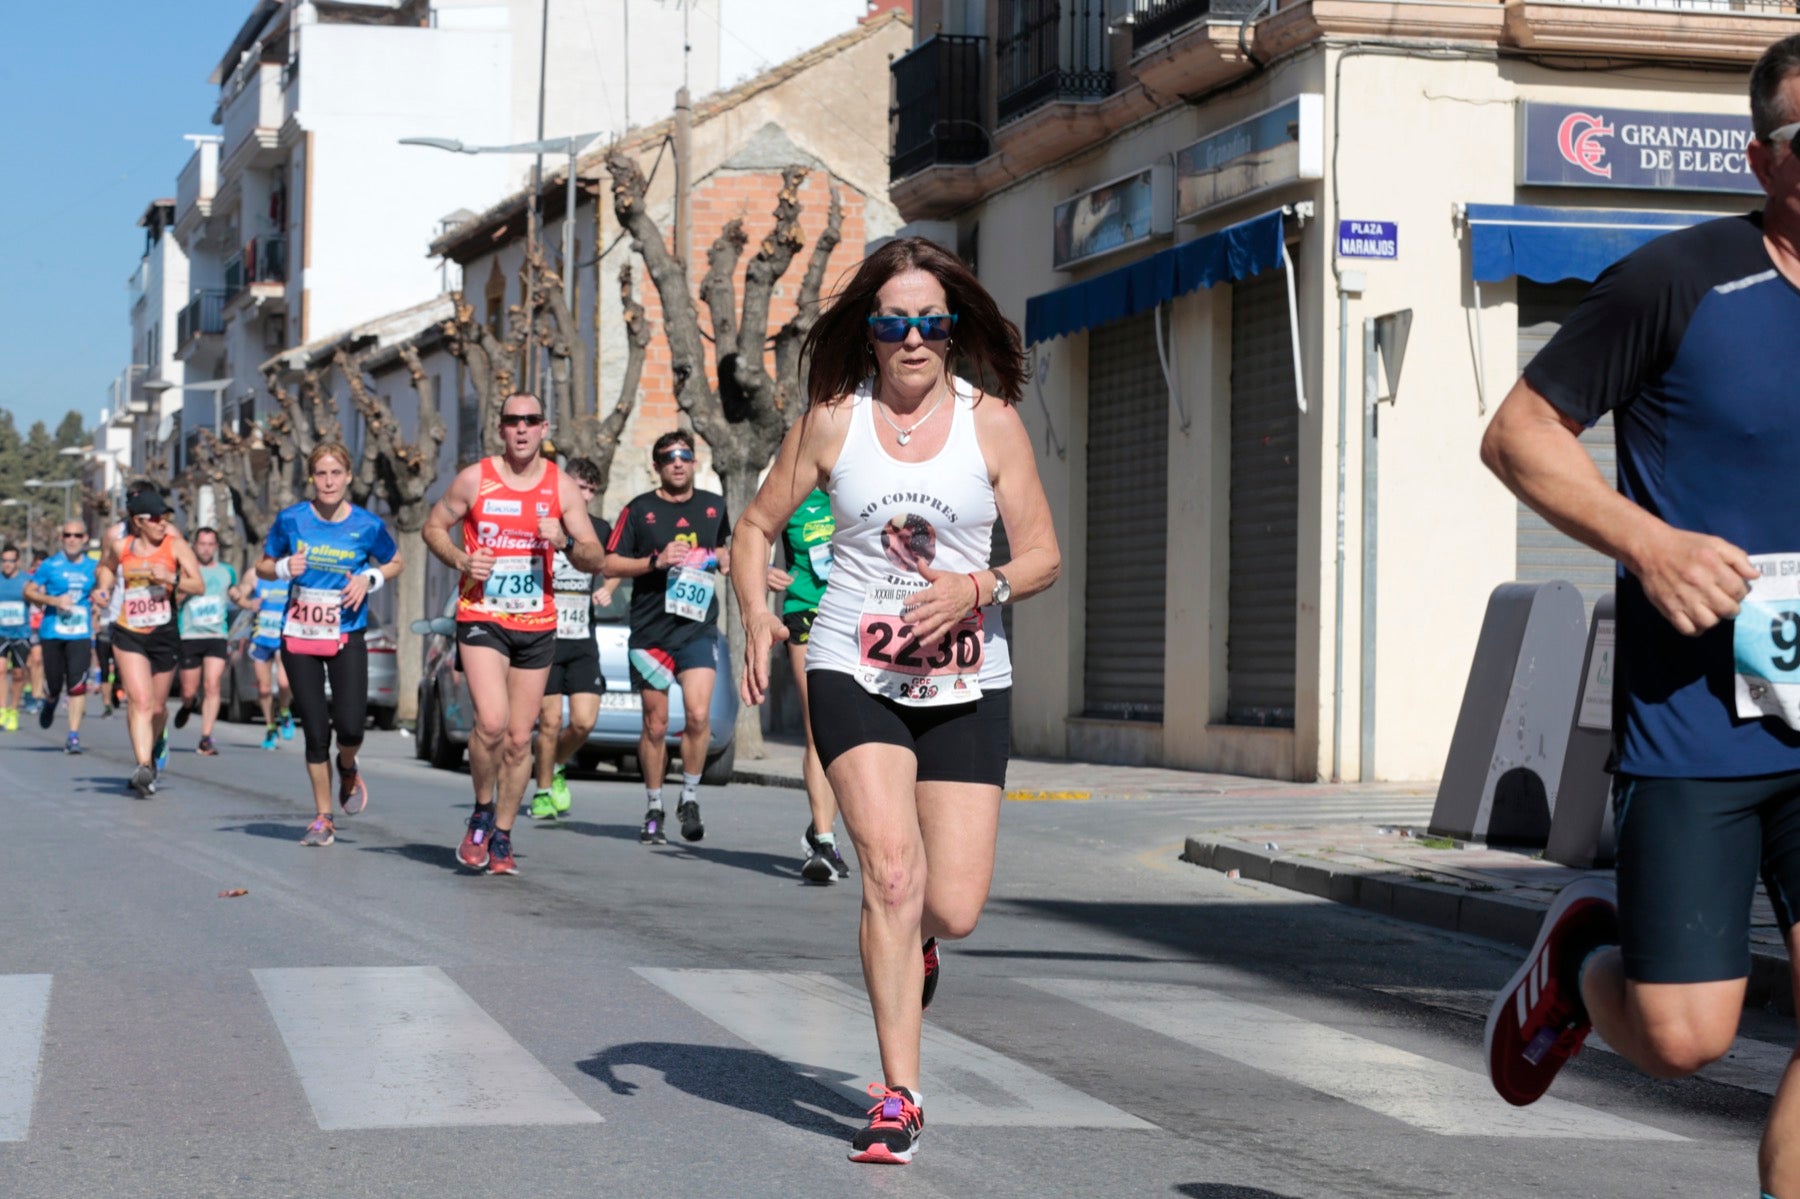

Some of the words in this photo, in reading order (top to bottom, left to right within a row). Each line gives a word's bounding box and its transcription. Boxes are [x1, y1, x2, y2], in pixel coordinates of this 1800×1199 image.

[1640, 149, 1674, 170] DE
[1351, 222, 1383, 235] PLAZA
[1341, 238, 1395, 256] NARANJOS
[859, 502, 878, 522] NO
[881, 492, 959, 523] COMPRES
[311, 544, 356, 560] olimpo
[495, 574, 535, 594] 738
[675, 582, 706, 604] 530
[875, 588, 895, 600] XXXIII
[896, 588, 919, 600] GRA
[129, 599, 166, 615] 2081
[291, 601, 337, 624] 2105
[556, 609, 586, 623] 148
[866, 621, 981, 669] 2230
